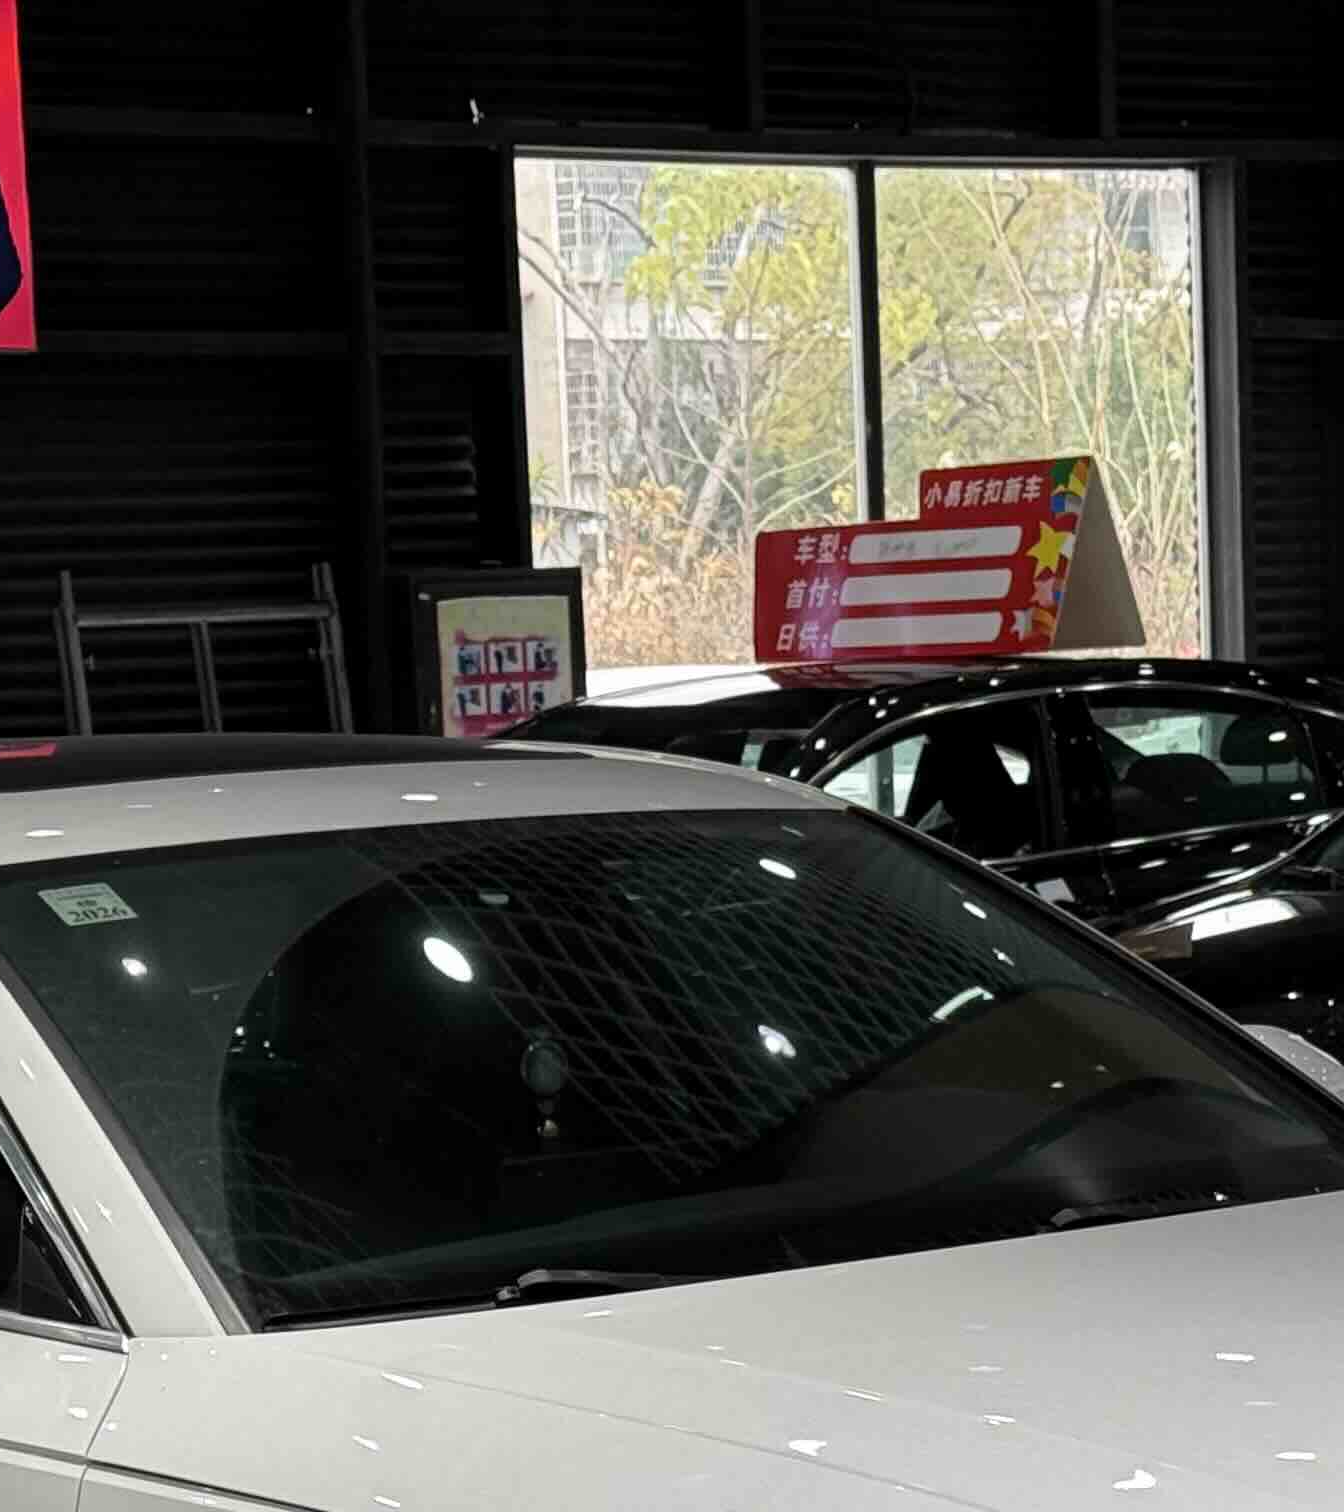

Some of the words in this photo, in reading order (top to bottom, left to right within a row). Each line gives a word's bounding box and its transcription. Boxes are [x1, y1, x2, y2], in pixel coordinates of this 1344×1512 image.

[924, 475, 1045, 509] 小易折扣新车
